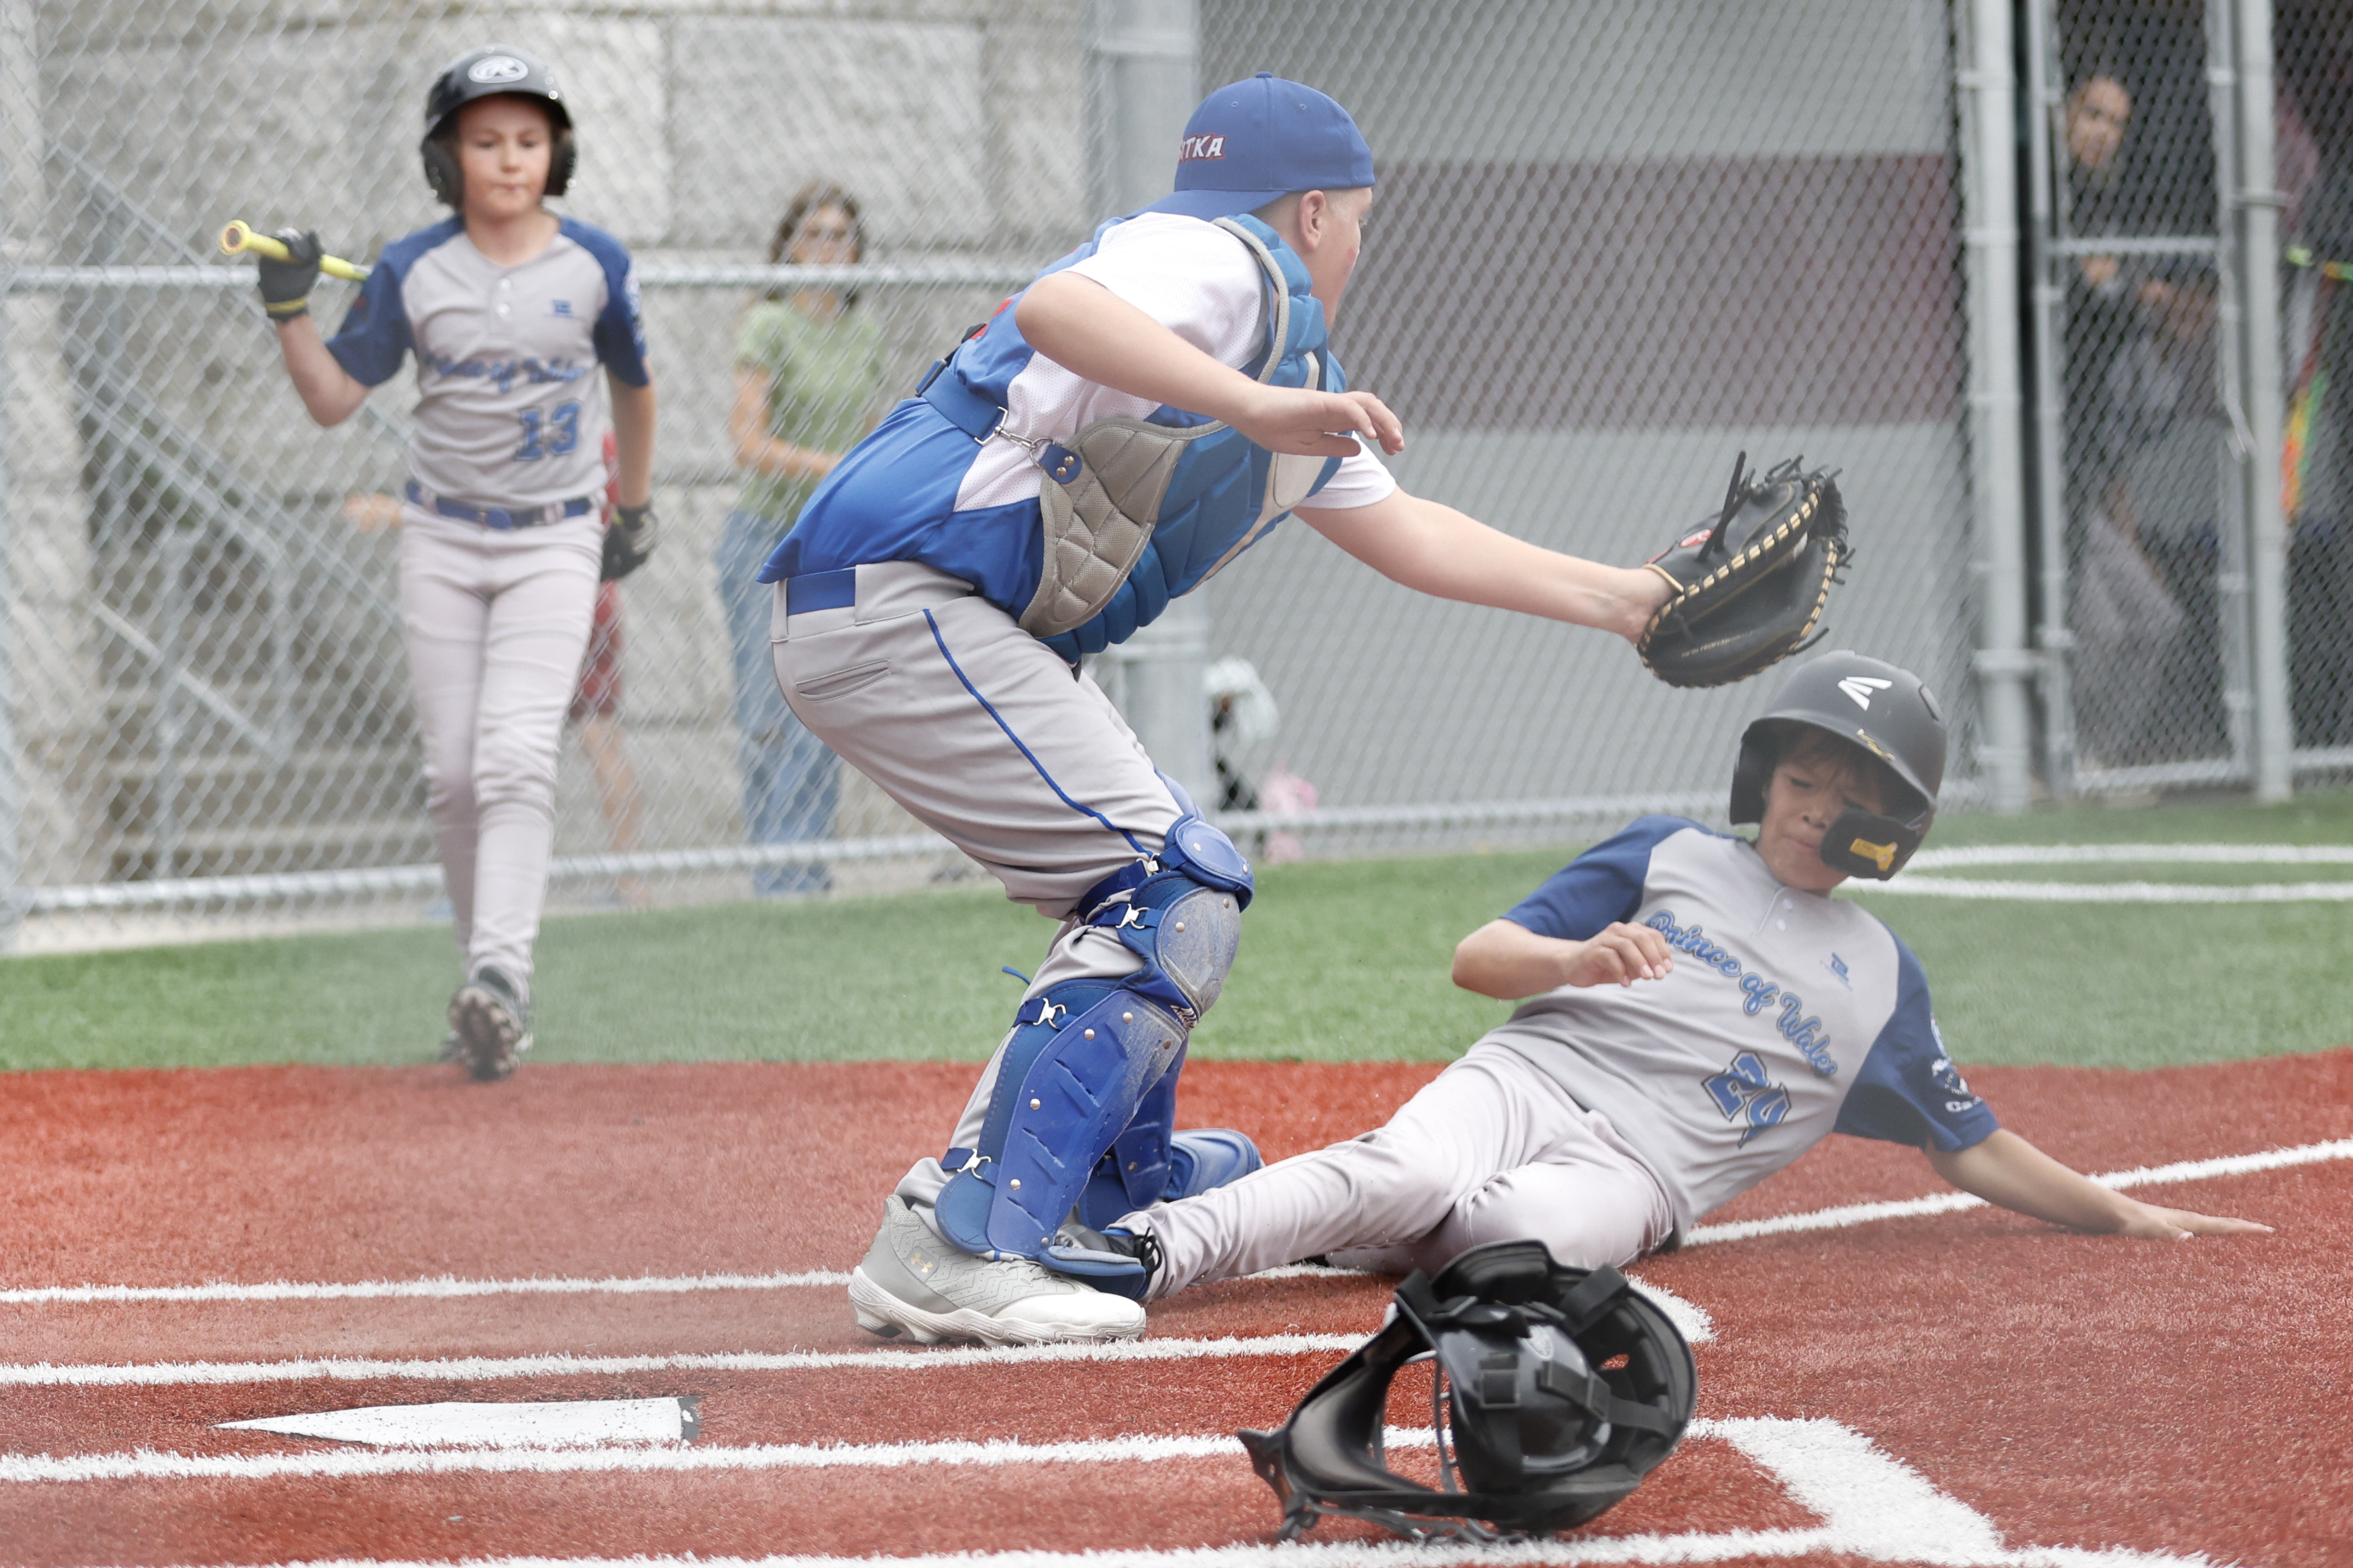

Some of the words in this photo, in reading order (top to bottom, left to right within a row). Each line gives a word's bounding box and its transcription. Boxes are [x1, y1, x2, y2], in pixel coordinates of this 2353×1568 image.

[514, 401, 581, 461] 13
[1647, 910, 1741, 977] Prince
[1740, 973, 1779, 1015] of
